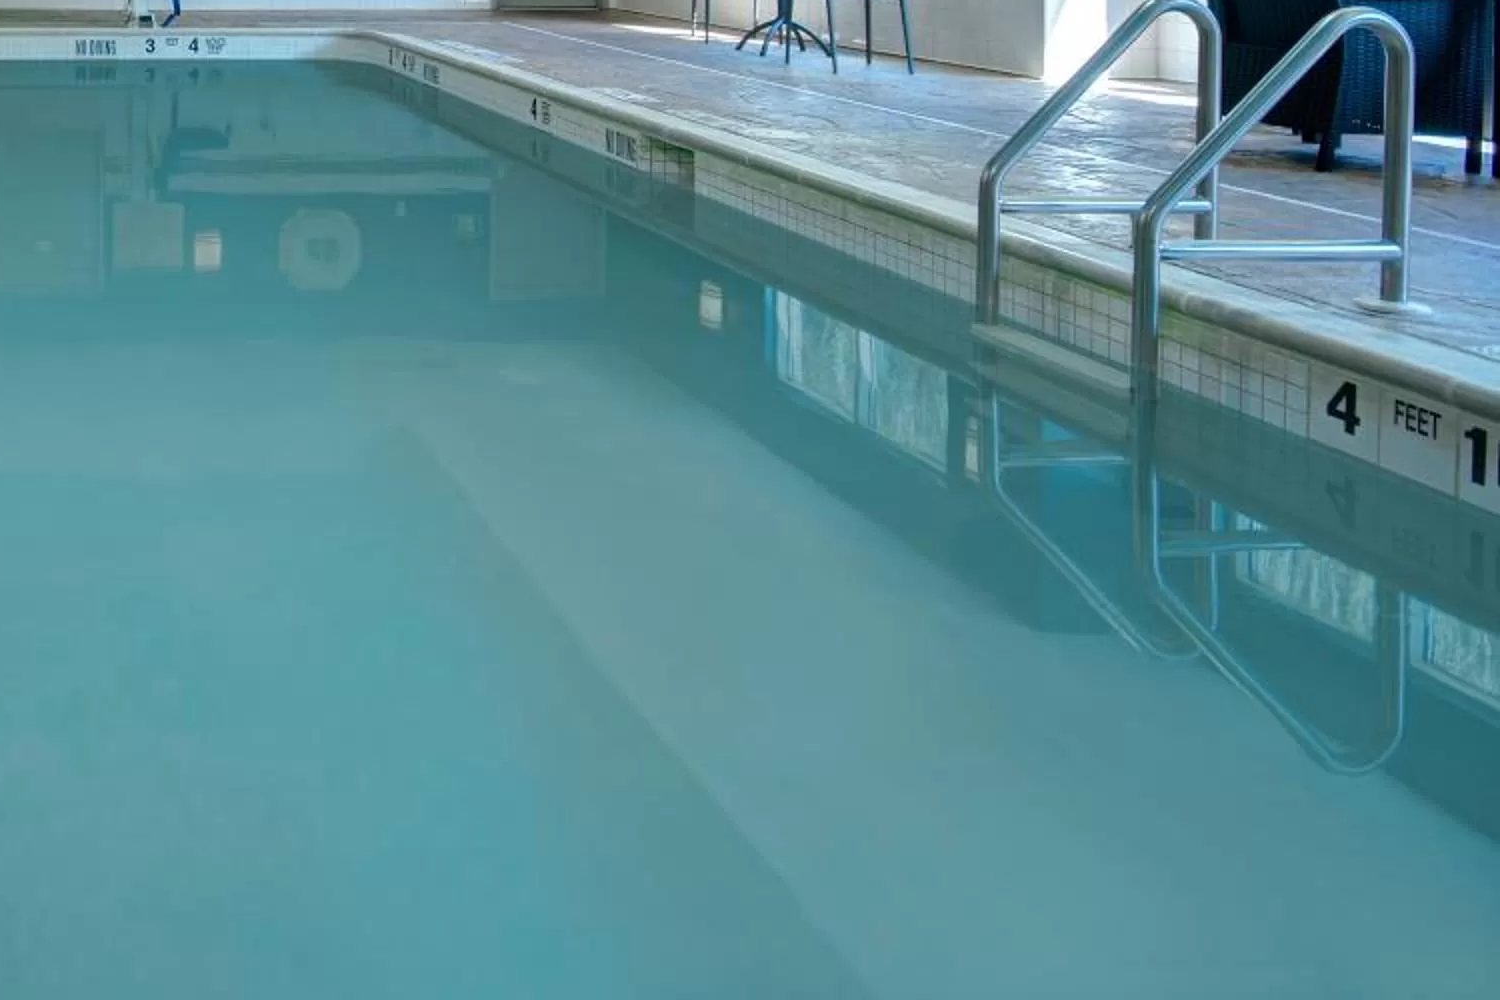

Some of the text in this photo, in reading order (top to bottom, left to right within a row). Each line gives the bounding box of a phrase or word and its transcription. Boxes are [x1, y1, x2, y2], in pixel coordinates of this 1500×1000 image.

[145, 38, 156, 53] 3
[188, 37, 199, 54] 4
[530, 97, 537, 120] 4
[1327, 381, 1500, 487] 4 FEET 1
